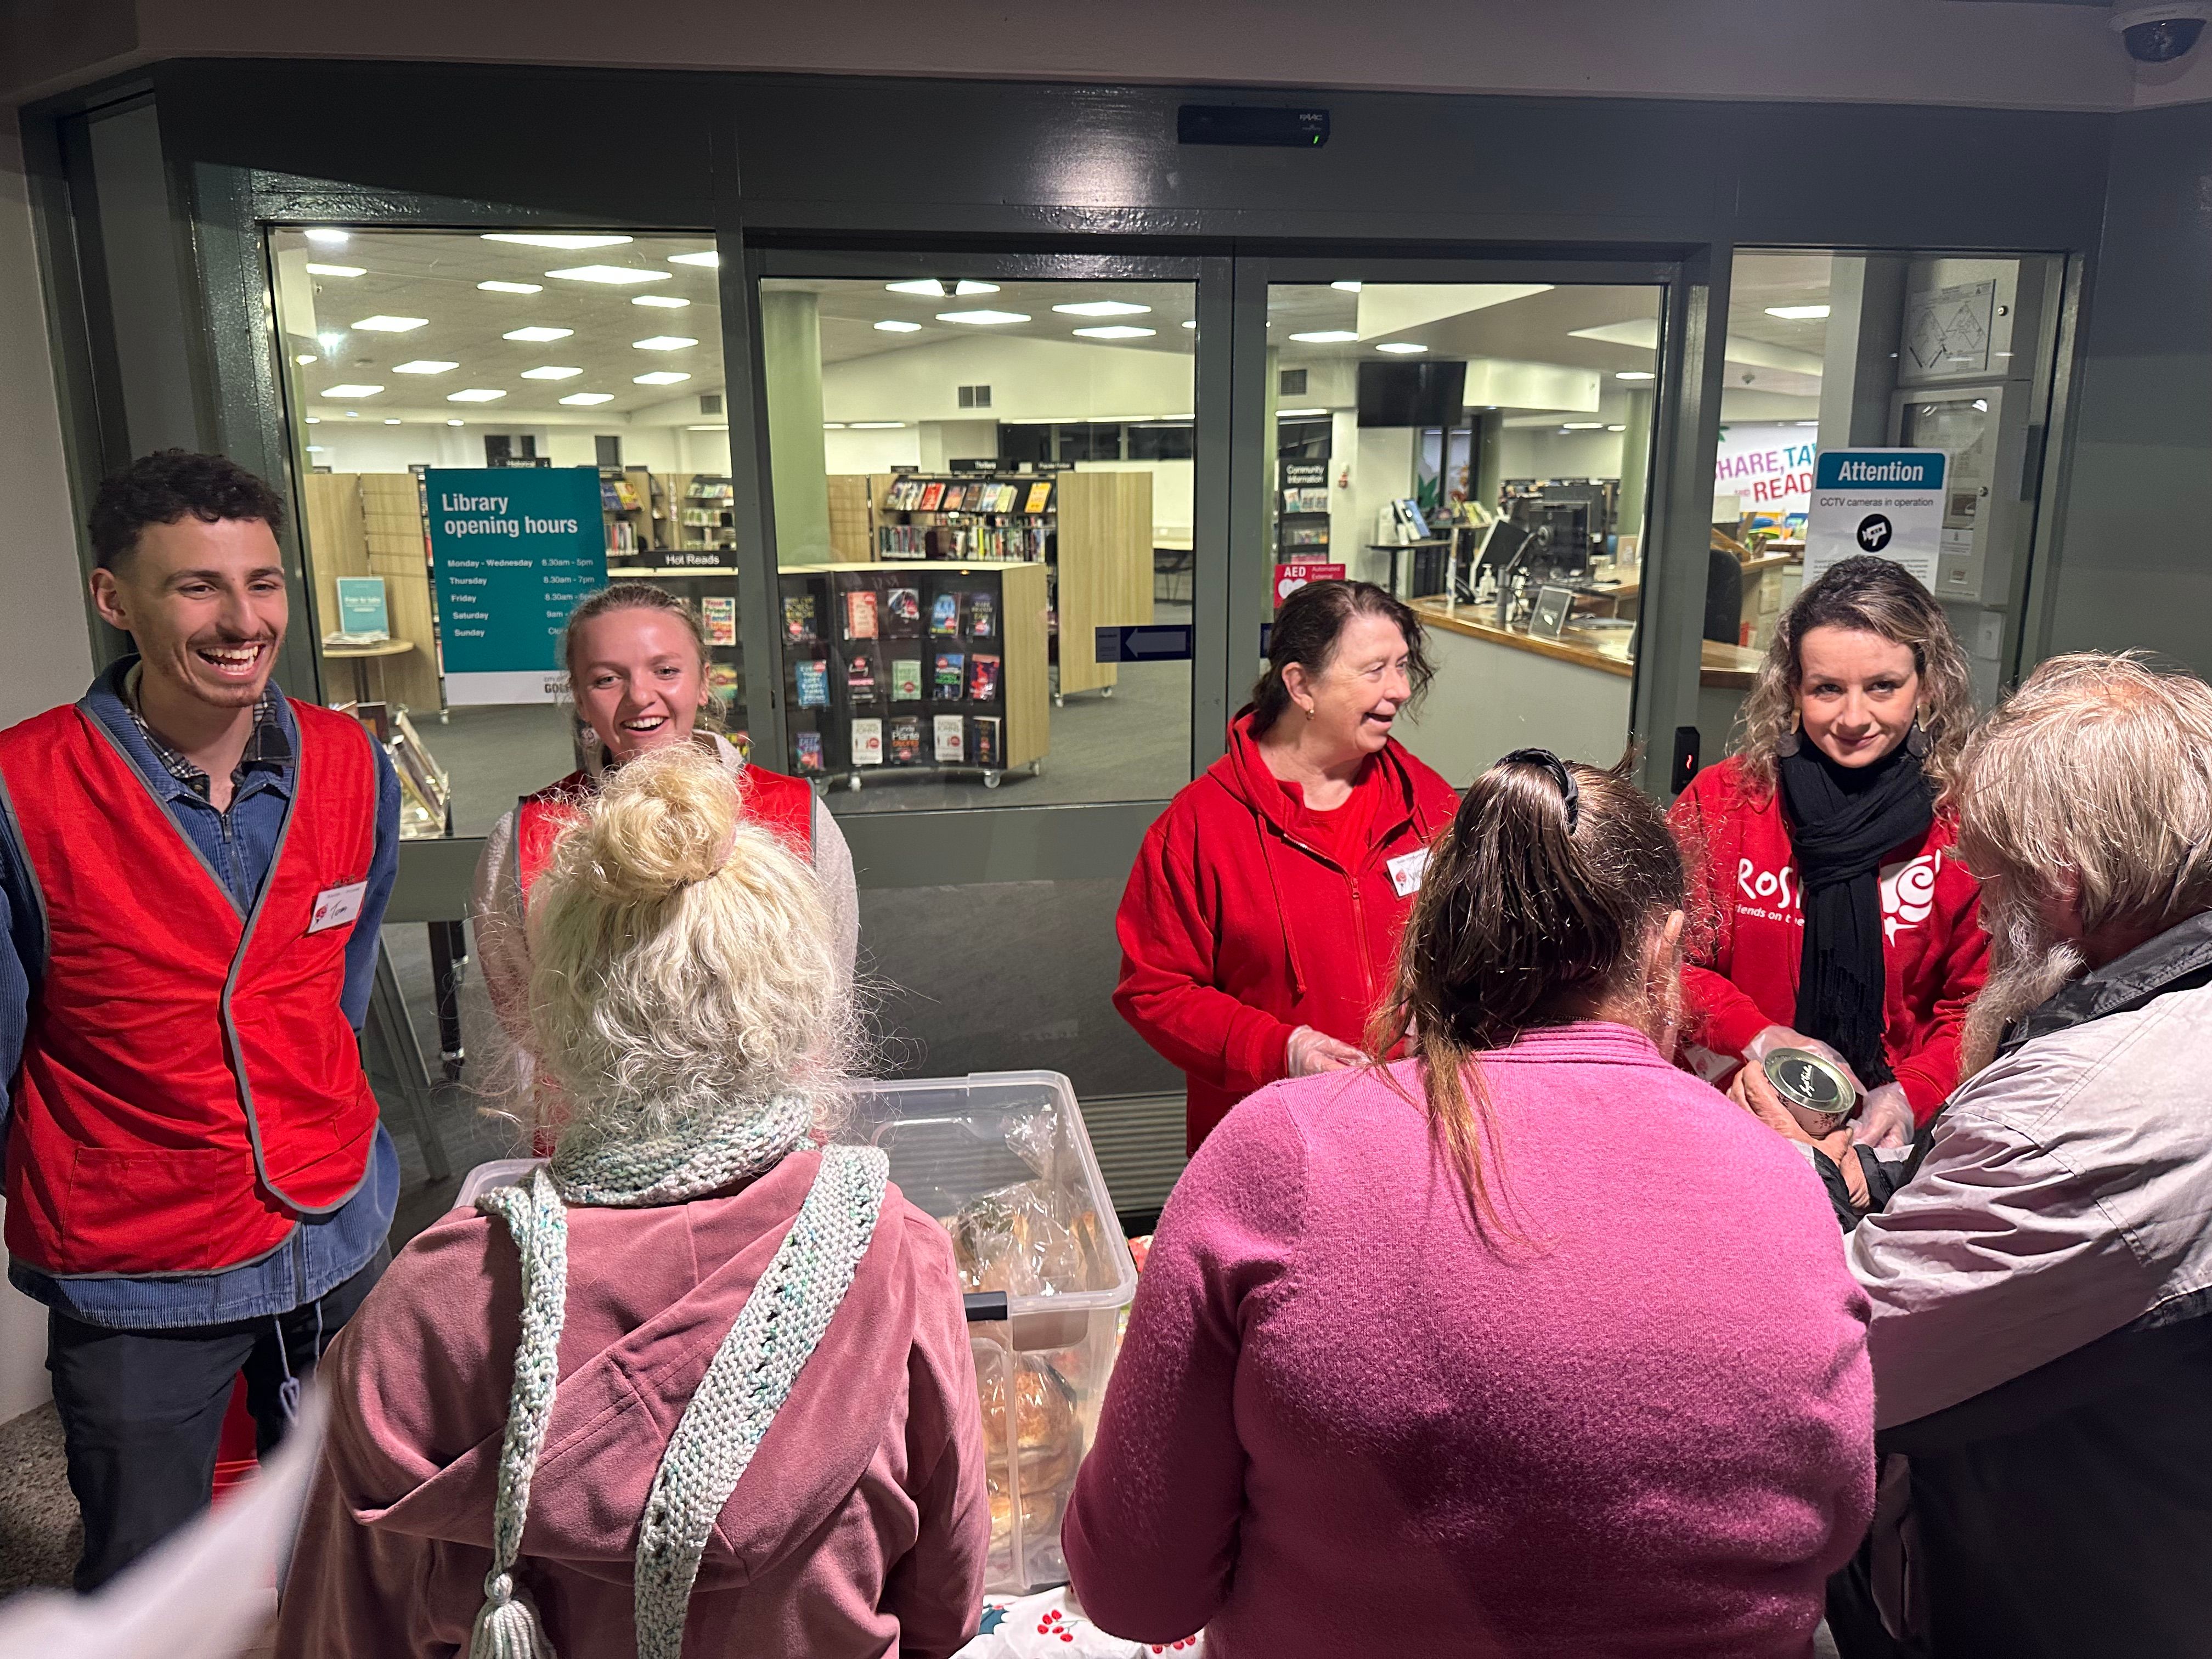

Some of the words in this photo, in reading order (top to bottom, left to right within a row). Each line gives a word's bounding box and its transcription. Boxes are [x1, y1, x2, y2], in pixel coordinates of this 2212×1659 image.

[1286, 464, 1325, 476] Community
[1716, 451, 1785, 480] HARE,
[1838, 461, 1923, 481] Attention
[1287, 474, 1324, 484] Information
[1753, 472, 1813, 503] READ
[442, 493, 509, 515] Library
[1820, 498, 1846, 507] CCTV
[1847, 499, 1882, 507] cameras
[1885, 498, 1893, 506] in
[1894, 498, 1934, 509] operation
[444, 516, 520, 538] opening
[524, 516, 578, 534] hours
[448, 559, 479, 568] Monday
[486, 559, 533, 568] Wednesday
[541, 558, 571, 567] 8.30am
[576, 558, 594, 567] 5pm
[665, 554, 685, 565] Hot
[686, 554, 720, 565] Reads
[1284, 567, 1306, 577] AED
[449, 577, 487, 586] Thursday
[578, 575, 595, 584] 7pm
[451, 594, 477, 603] Friday
[545, 592, 573, 601] 8.30am
[453, 611, 489, 620] Saturday
[546, 610, 563, 618] 9am
[454, 629, 485, 637] Sunday
[1735, 904, 1767, 918] iends
[1768, 911, 1782, 921] on
